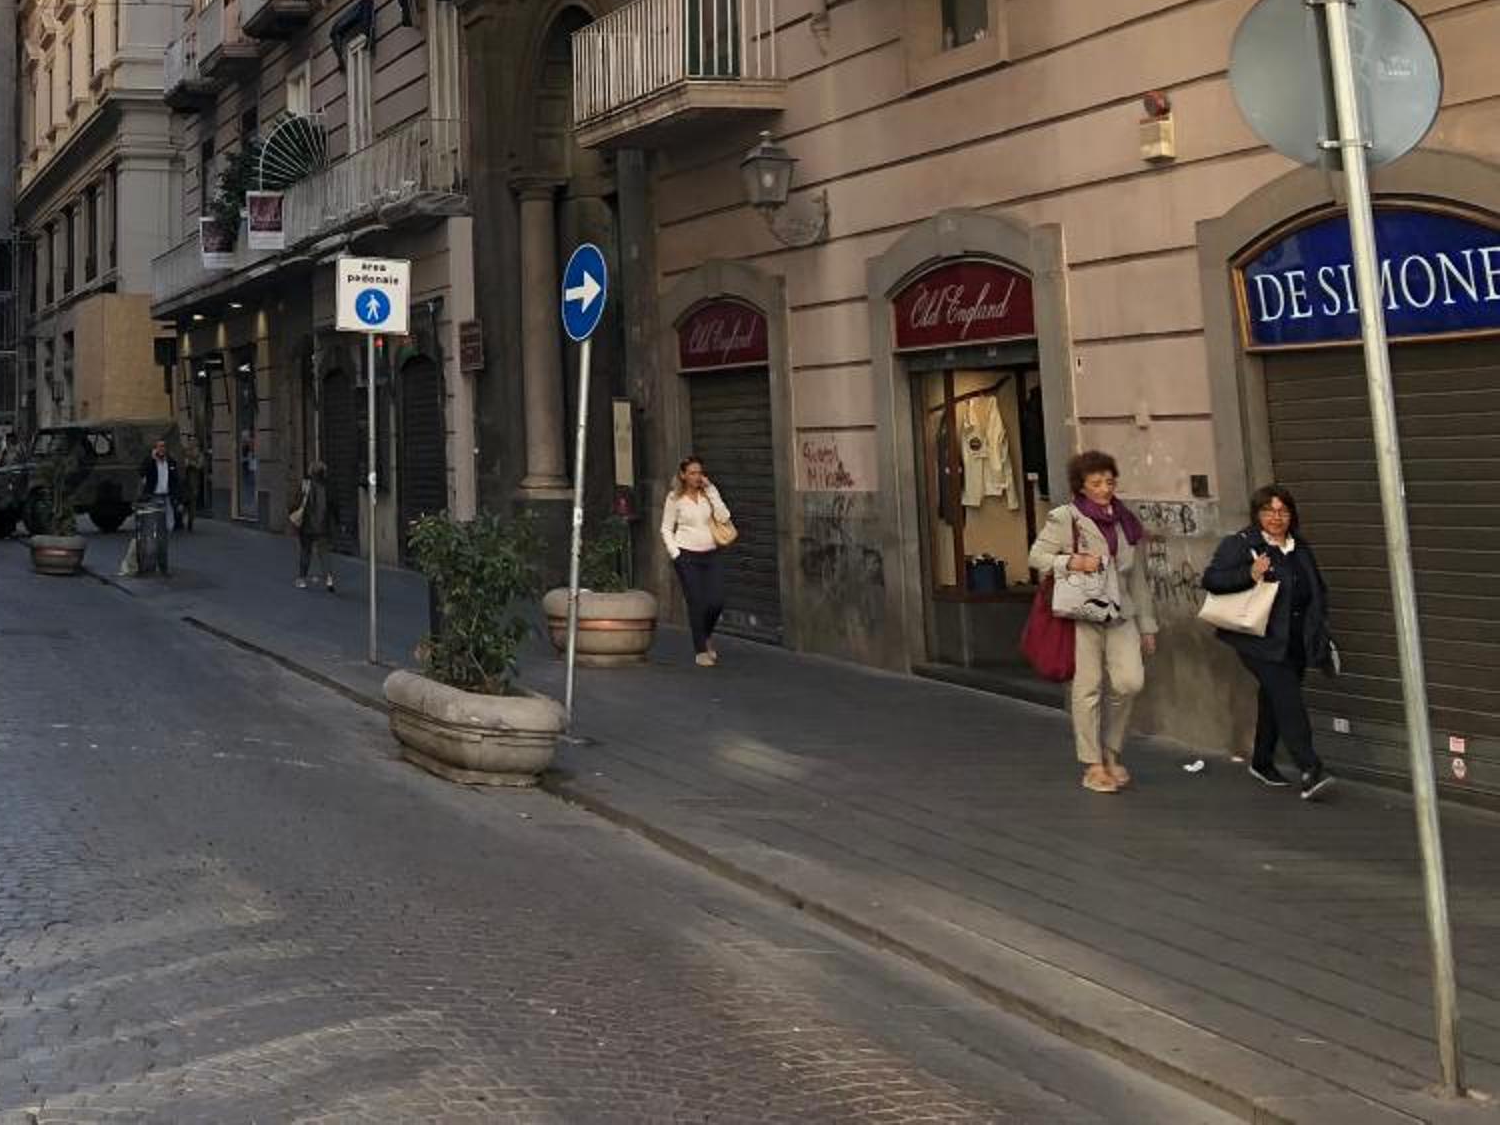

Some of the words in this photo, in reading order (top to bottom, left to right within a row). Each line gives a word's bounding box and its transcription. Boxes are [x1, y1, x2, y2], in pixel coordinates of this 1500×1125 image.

[347, 274, 400, 286] pedonale
[361, 262, 387, 272] area
[910, 283, 947, 329] Old
[946, 276, 1017, 340] England
[1254, 270, 1313, 322] DE
